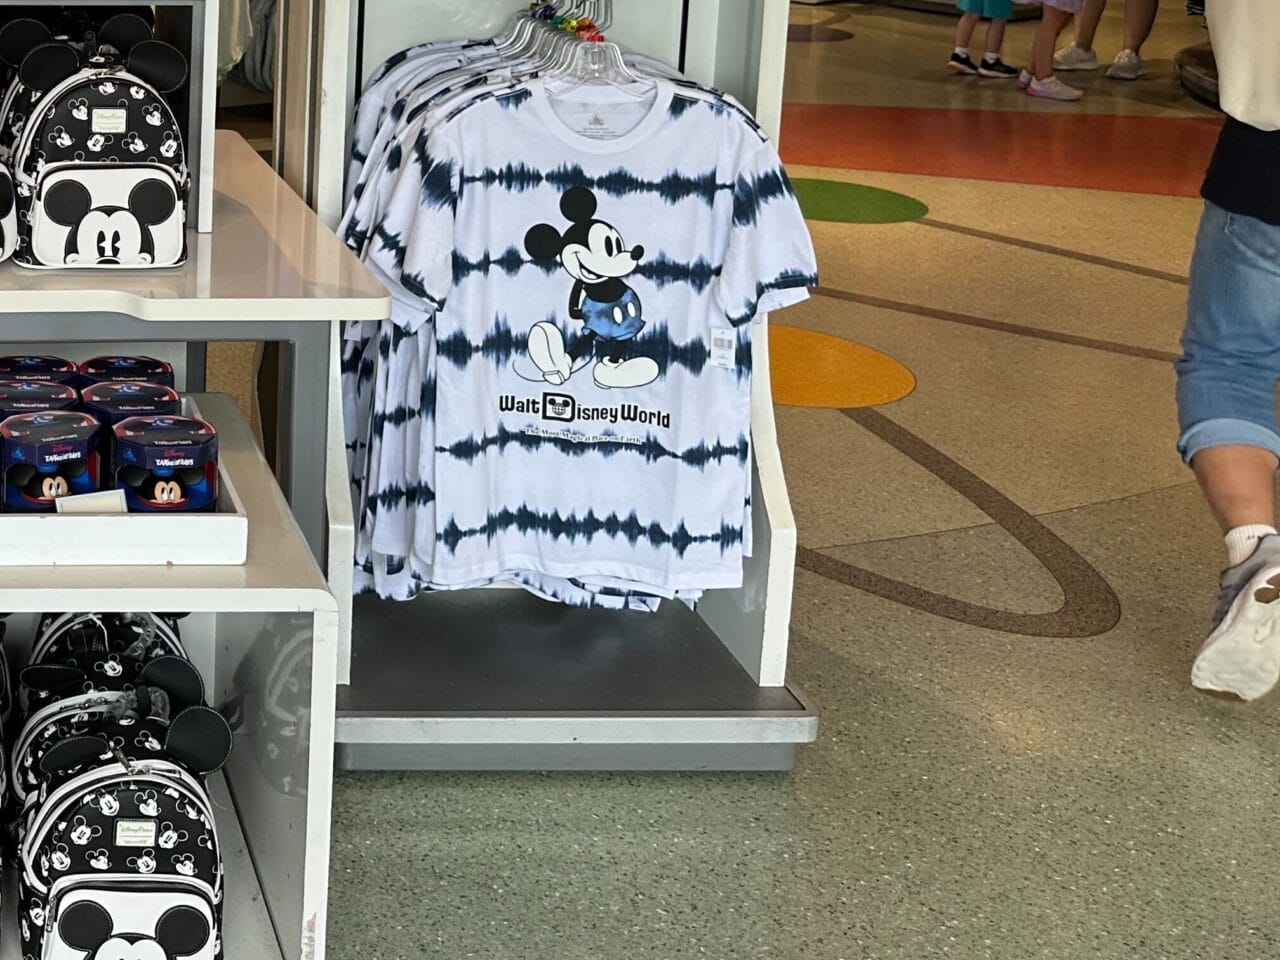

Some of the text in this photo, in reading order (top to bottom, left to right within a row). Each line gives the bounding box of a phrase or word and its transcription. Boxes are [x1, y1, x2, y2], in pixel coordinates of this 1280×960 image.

[499, 392, 670, 429] Walt Disney World
